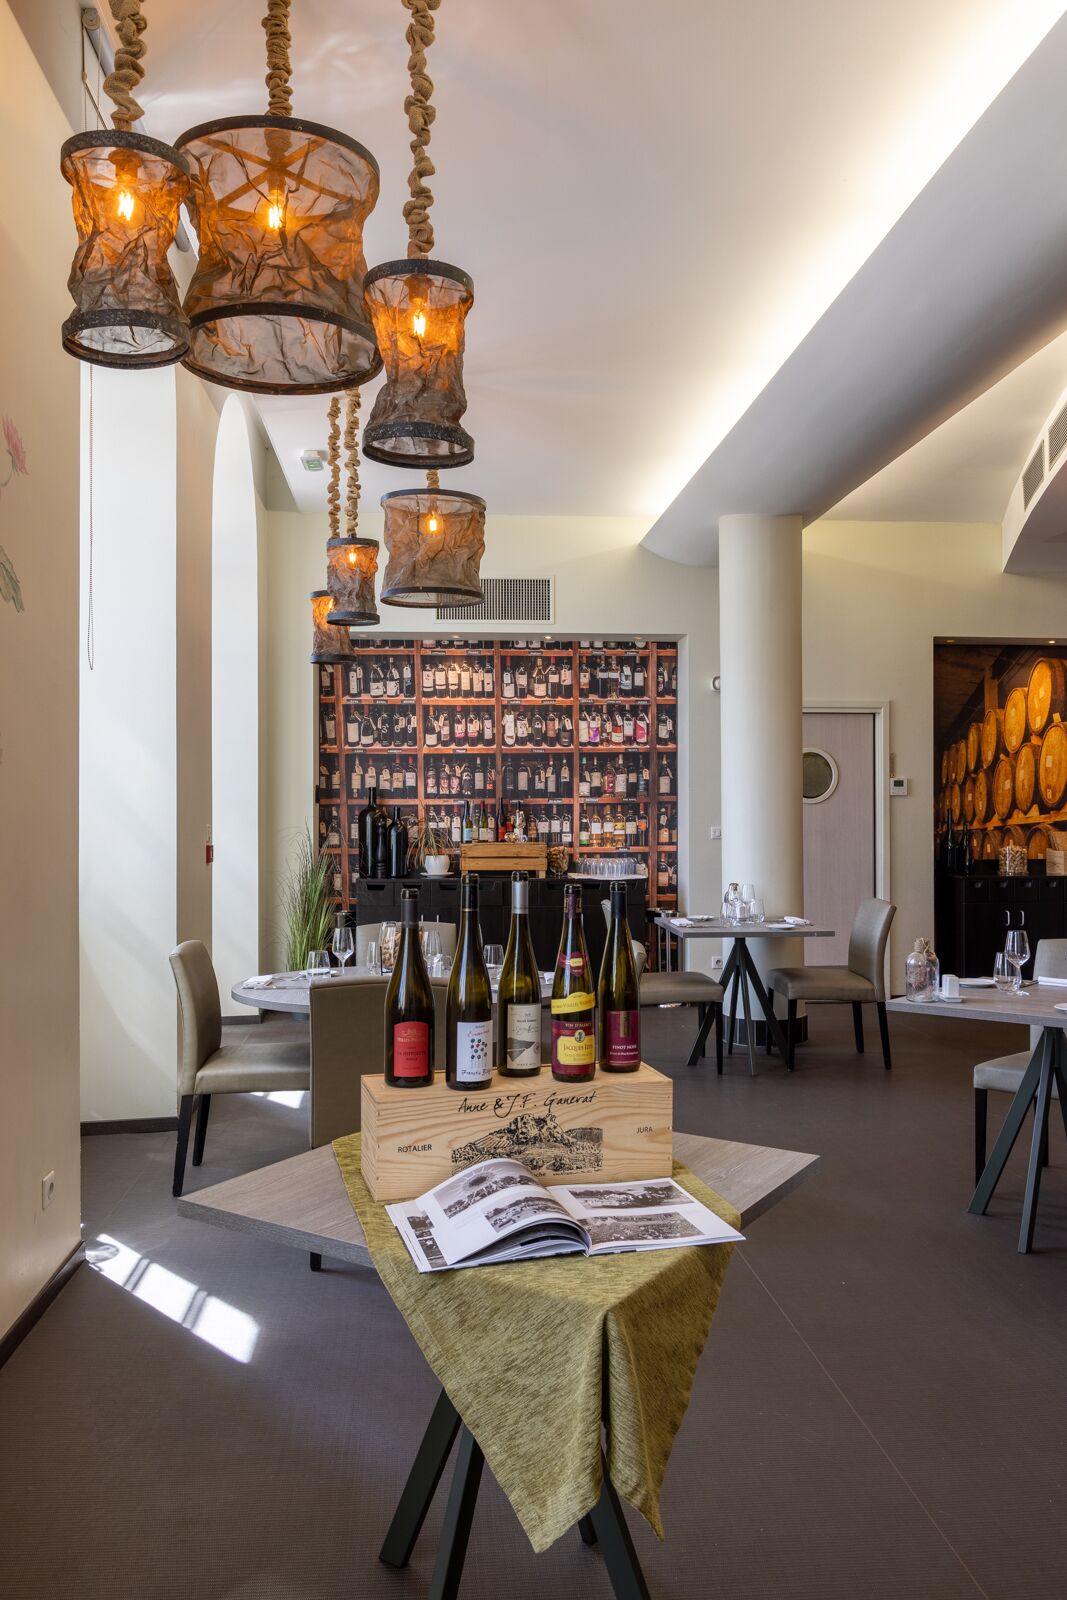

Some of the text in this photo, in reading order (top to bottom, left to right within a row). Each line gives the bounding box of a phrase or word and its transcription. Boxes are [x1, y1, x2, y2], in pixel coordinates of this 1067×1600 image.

[457, 1097, 489, 1113] Anne
[636, 1126, 653, 1134] JURA
[397, 1144, 433, 1153] ROTALIER
